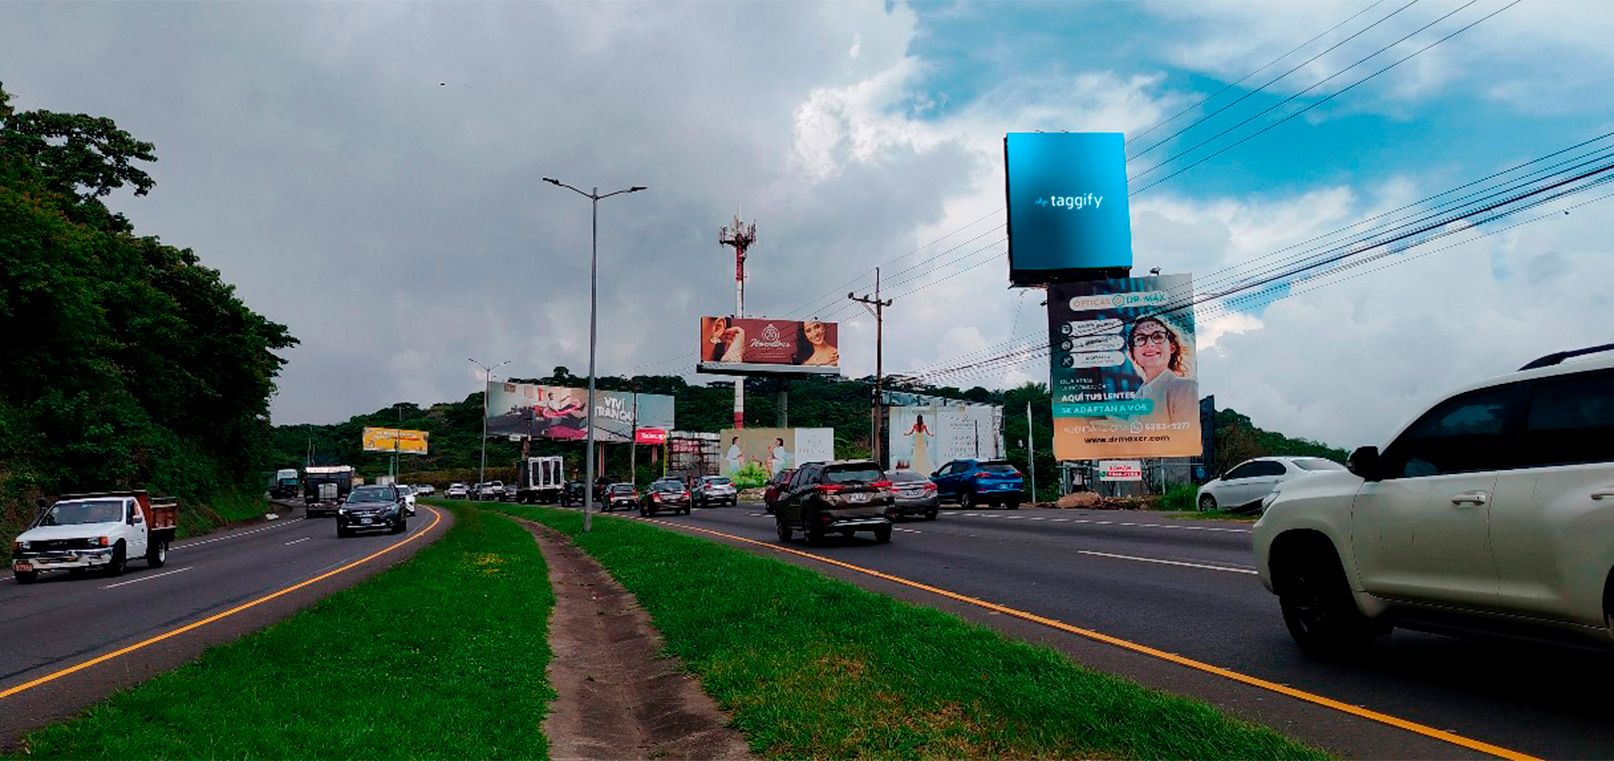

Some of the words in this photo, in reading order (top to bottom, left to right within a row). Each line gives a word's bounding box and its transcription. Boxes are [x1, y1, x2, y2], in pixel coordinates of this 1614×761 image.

[1050, 192, 1103, 210] taggify
[1061, 392, 1084, 403] AQUÍ
[1085, 392, 1103, 402] TUS
[1103, 391, 1136, 400] LENTES
[1073, 405, 1118, 414] ADAPTAN
[1119, 404, 1127, 412] A
[1128, 403, 1148, 412] VOS
[1083, 434, 1170, 445] www.drmaxcr.com
